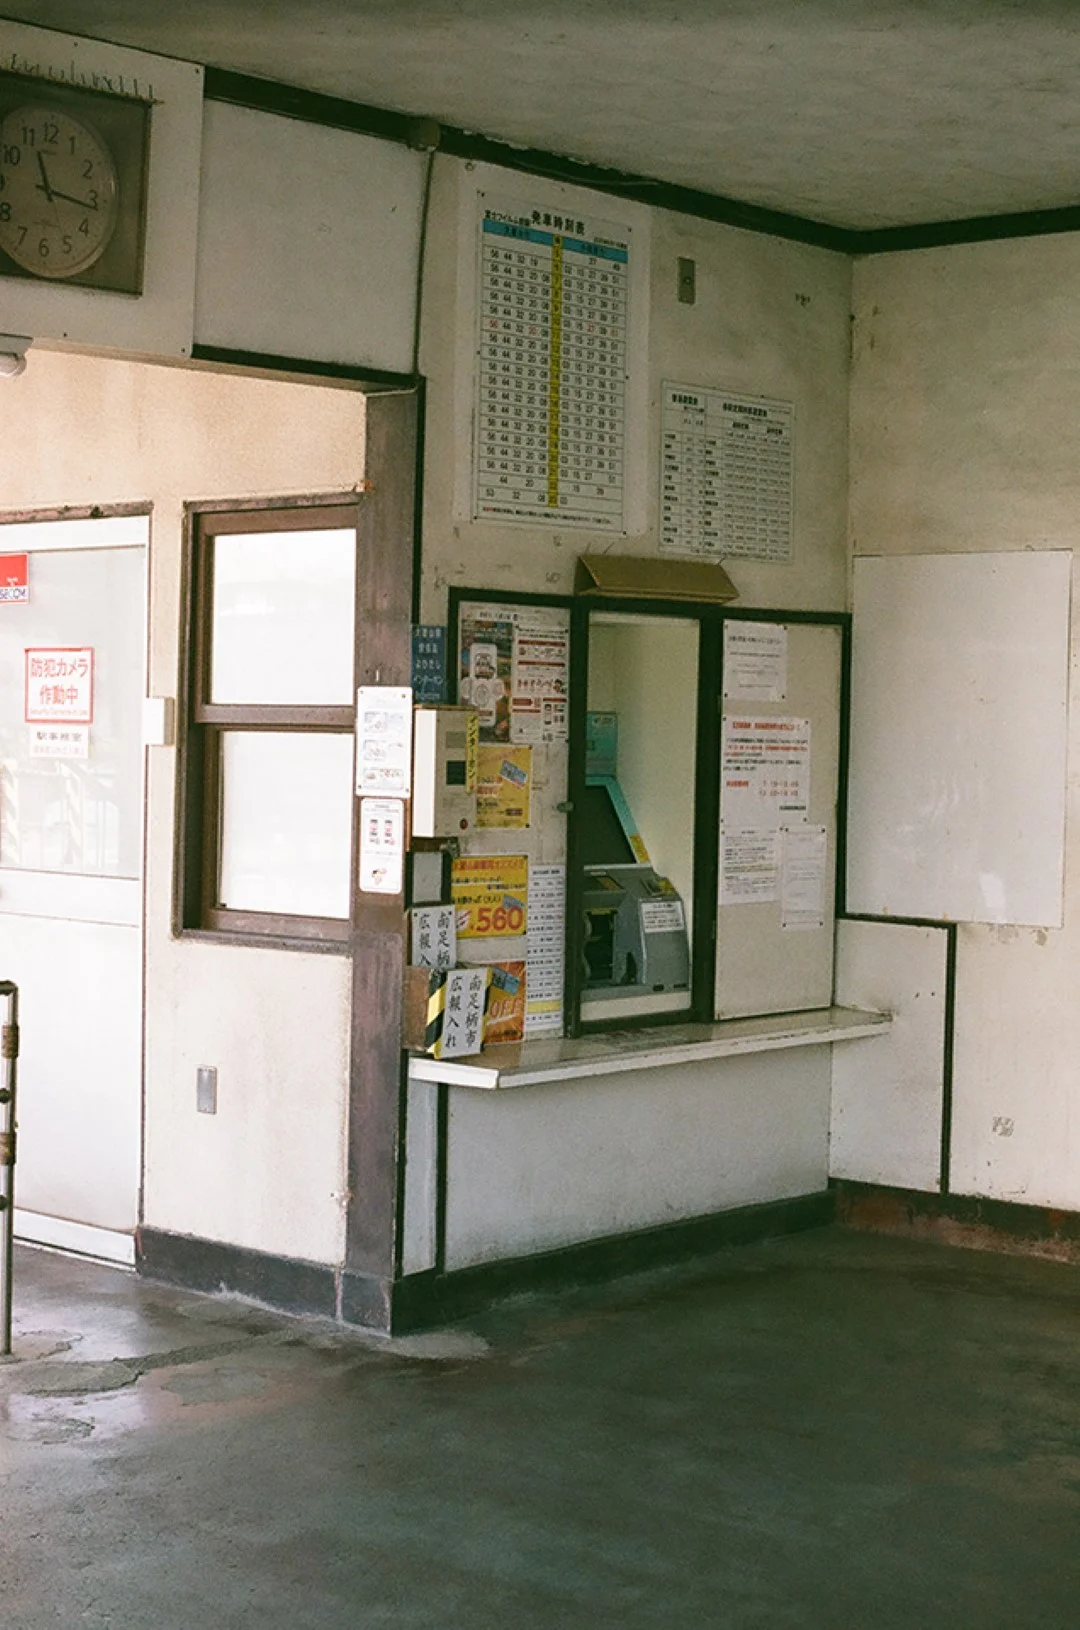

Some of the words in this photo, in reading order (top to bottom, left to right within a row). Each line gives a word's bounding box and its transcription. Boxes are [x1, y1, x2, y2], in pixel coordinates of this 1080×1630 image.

[22, 126, 35, 146] 11
[44, 122, 58, 144] 12
[3, 145, 20, 165] 10
[69, 136, 75, 155] 1
[83, 160, 93, 180] 2
[88, 189, 98, 209] 3
[0, 203, 11, 221] 8
[79, 217, 89, 237] 4
[532, 210, 585, 236] 発車時刻表
[18, 225, 28, 246] 7
[62, 236, 72, 254] 5
[38, 239, 49, 257] 6
[30, 657, 88, 678] 防犯カメラ
[39, 684, 79, 705] 作動中
[445, 975, 462, 1048] 広報入れ
[465, 974, 483, 1048] 南足柄市
